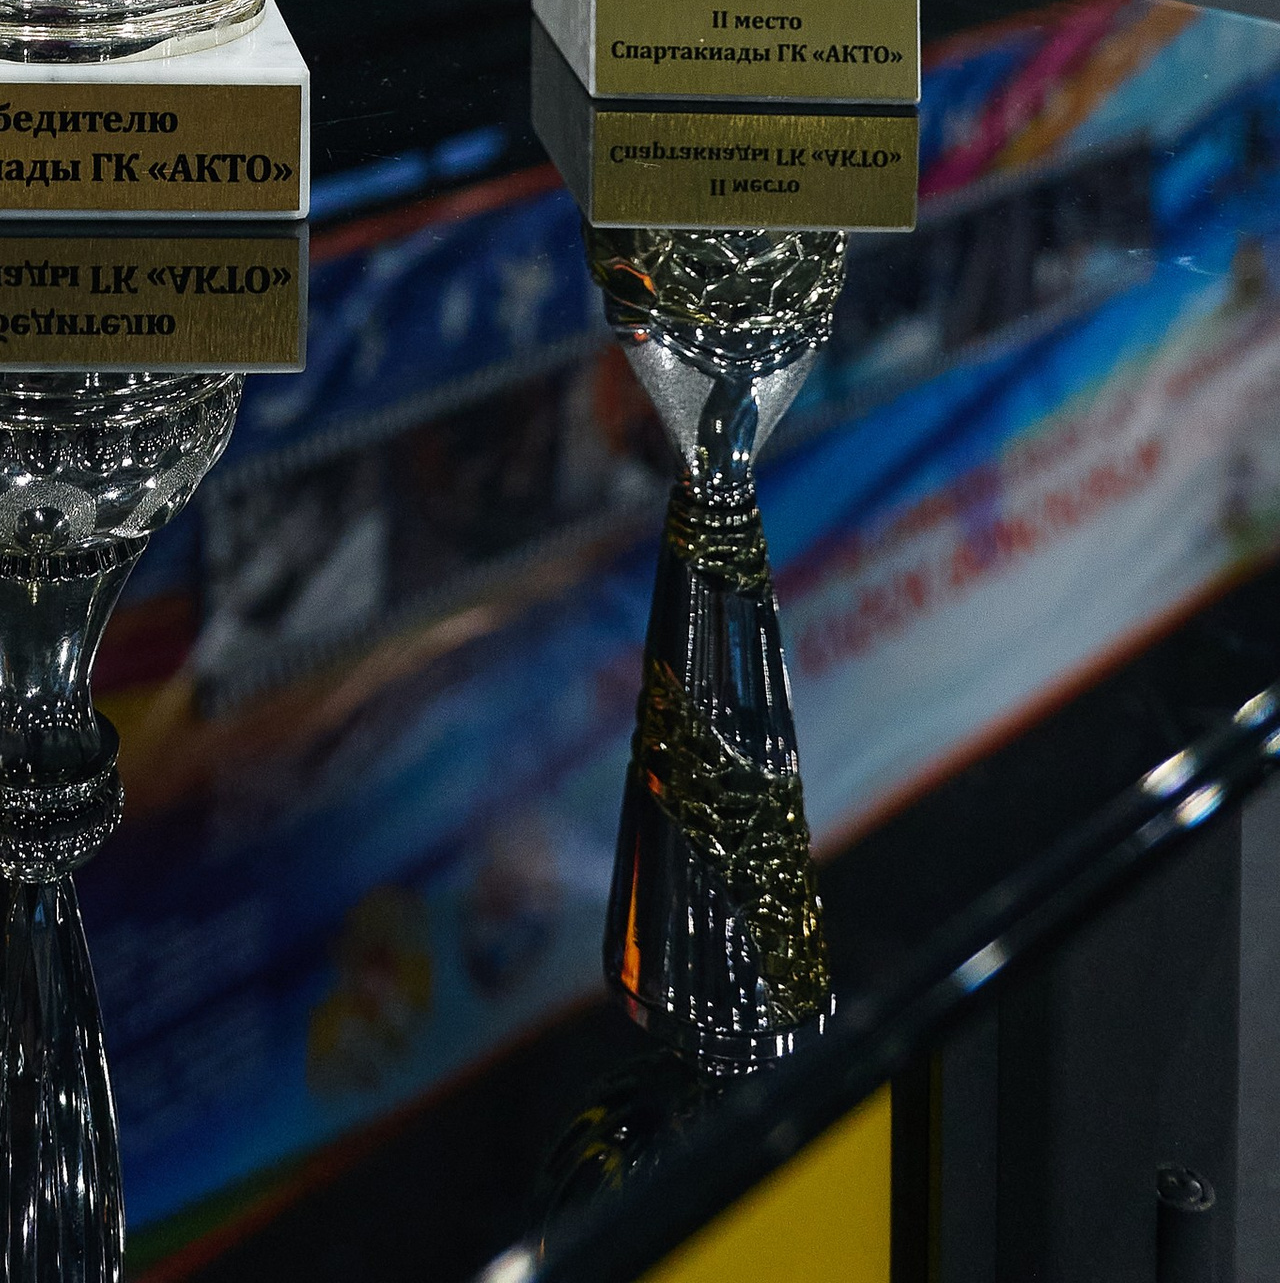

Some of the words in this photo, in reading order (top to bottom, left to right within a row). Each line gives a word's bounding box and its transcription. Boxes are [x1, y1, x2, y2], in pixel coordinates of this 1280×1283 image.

[712, 10, 728, 29] II
[734, 15, 802, 31] место
[611, 40, 771, 65] Спартакиады
[777, 43, 808, 63] ГК
[812, 44, 903, 64] «АКТО»
[91, 152, 140, 182] ГК
[148, 153, 293, 183] «АКТО»
